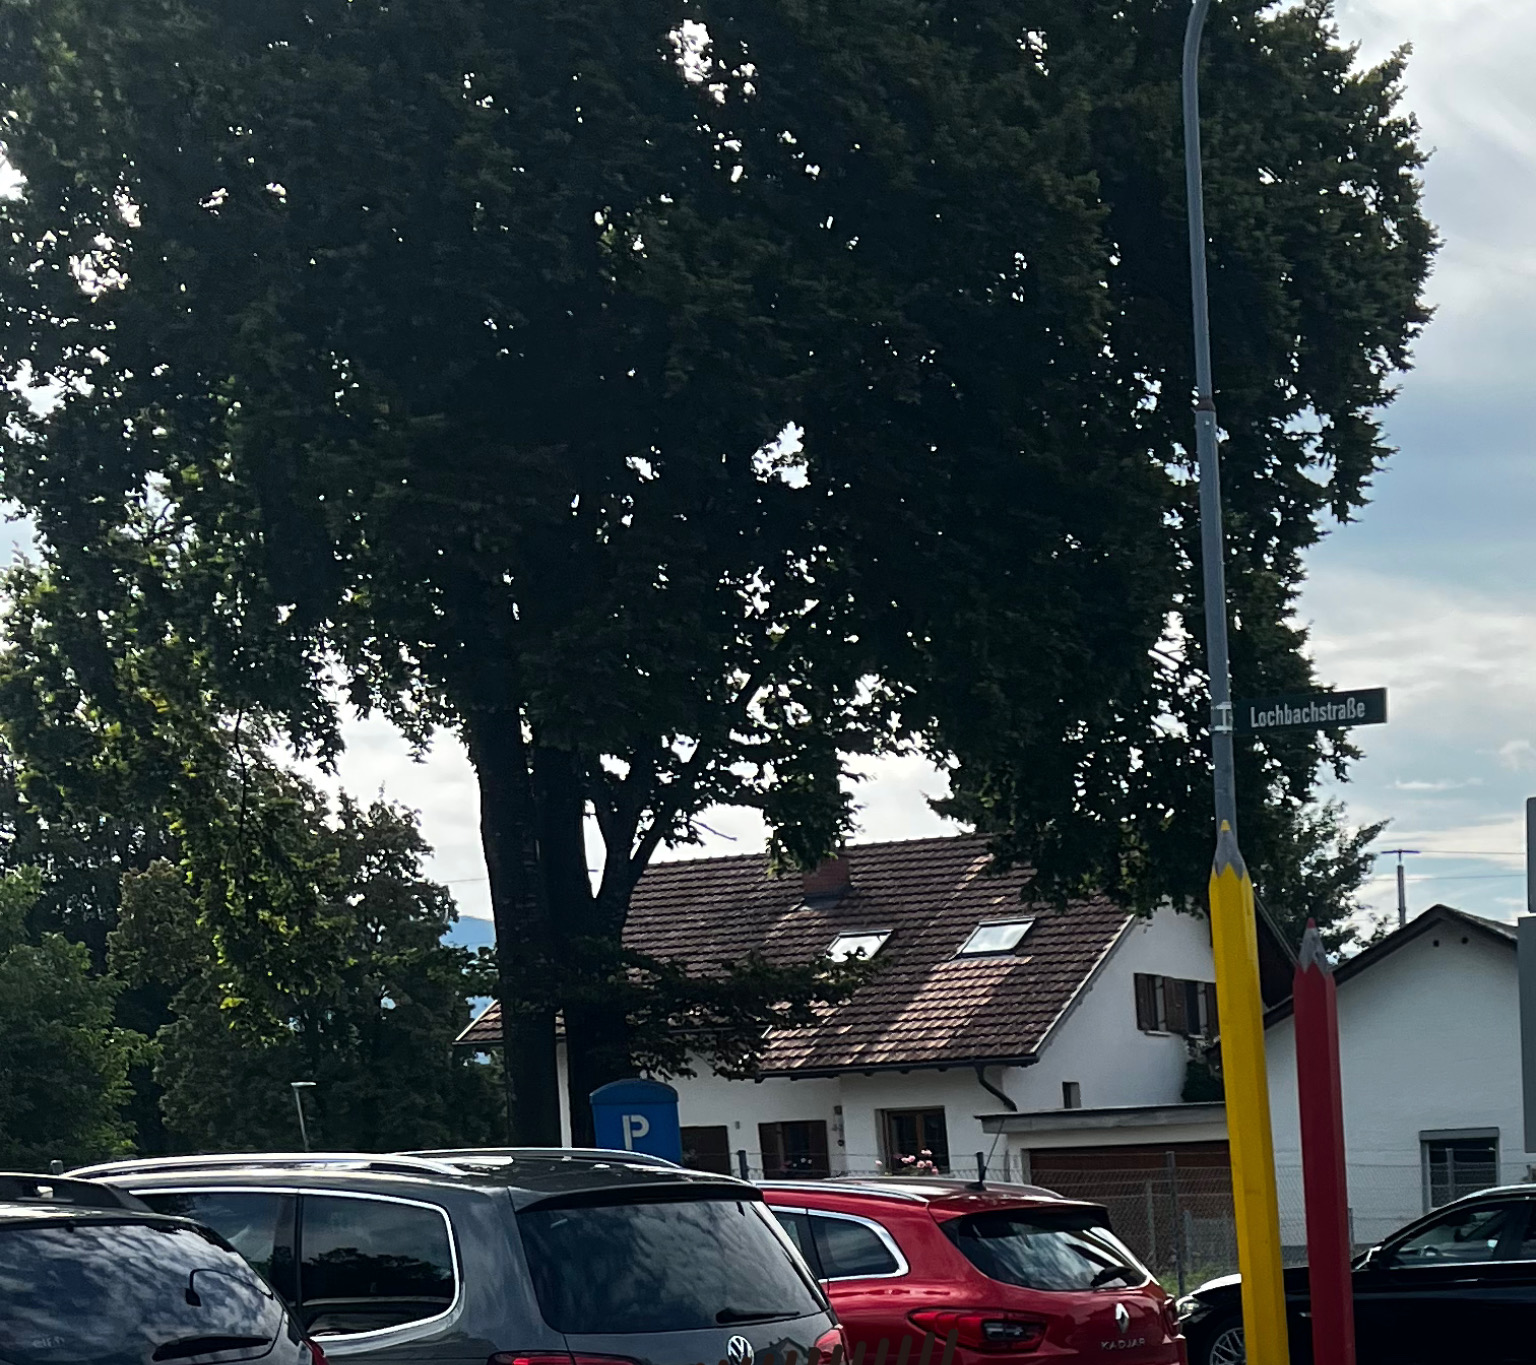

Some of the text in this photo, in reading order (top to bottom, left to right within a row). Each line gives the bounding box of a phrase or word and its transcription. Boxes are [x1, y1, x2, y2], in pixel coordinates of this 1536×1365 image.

[1250, 697, 1365, 728] Lochbachstraße
[622, 1114, 650, 1150] P
[1101, 1338, 1145, 1350] KADJAR
